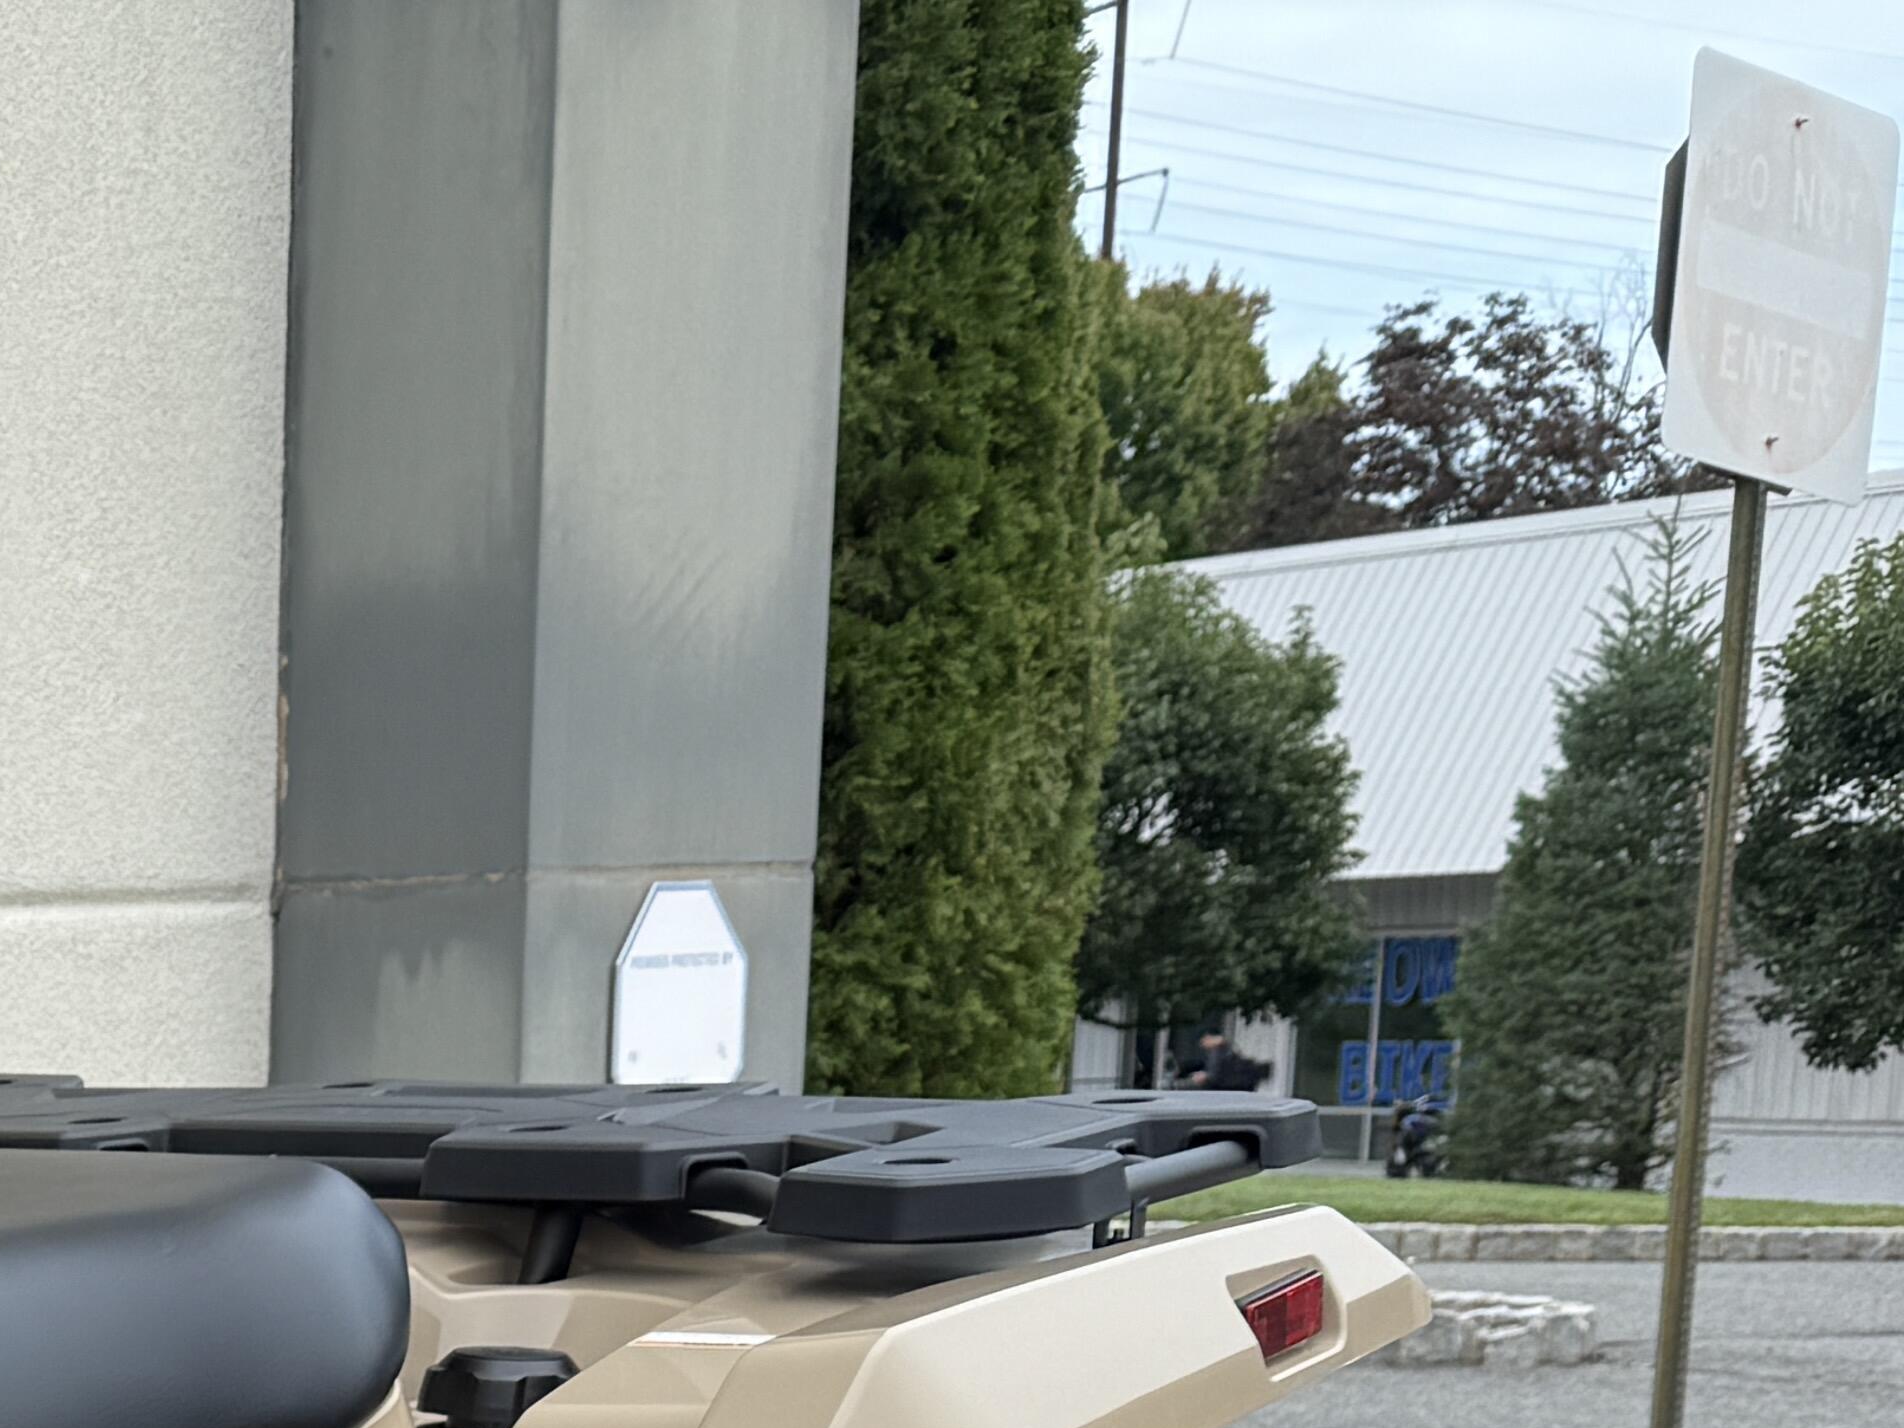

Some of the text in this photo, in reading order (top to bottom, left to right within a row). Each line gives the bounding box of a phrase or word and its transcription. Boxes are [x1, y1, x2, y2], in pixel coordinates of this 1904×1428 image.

[1722, 153, 1861, 244] DO NOT
[1718, 322, 1835, 408] ENTER
